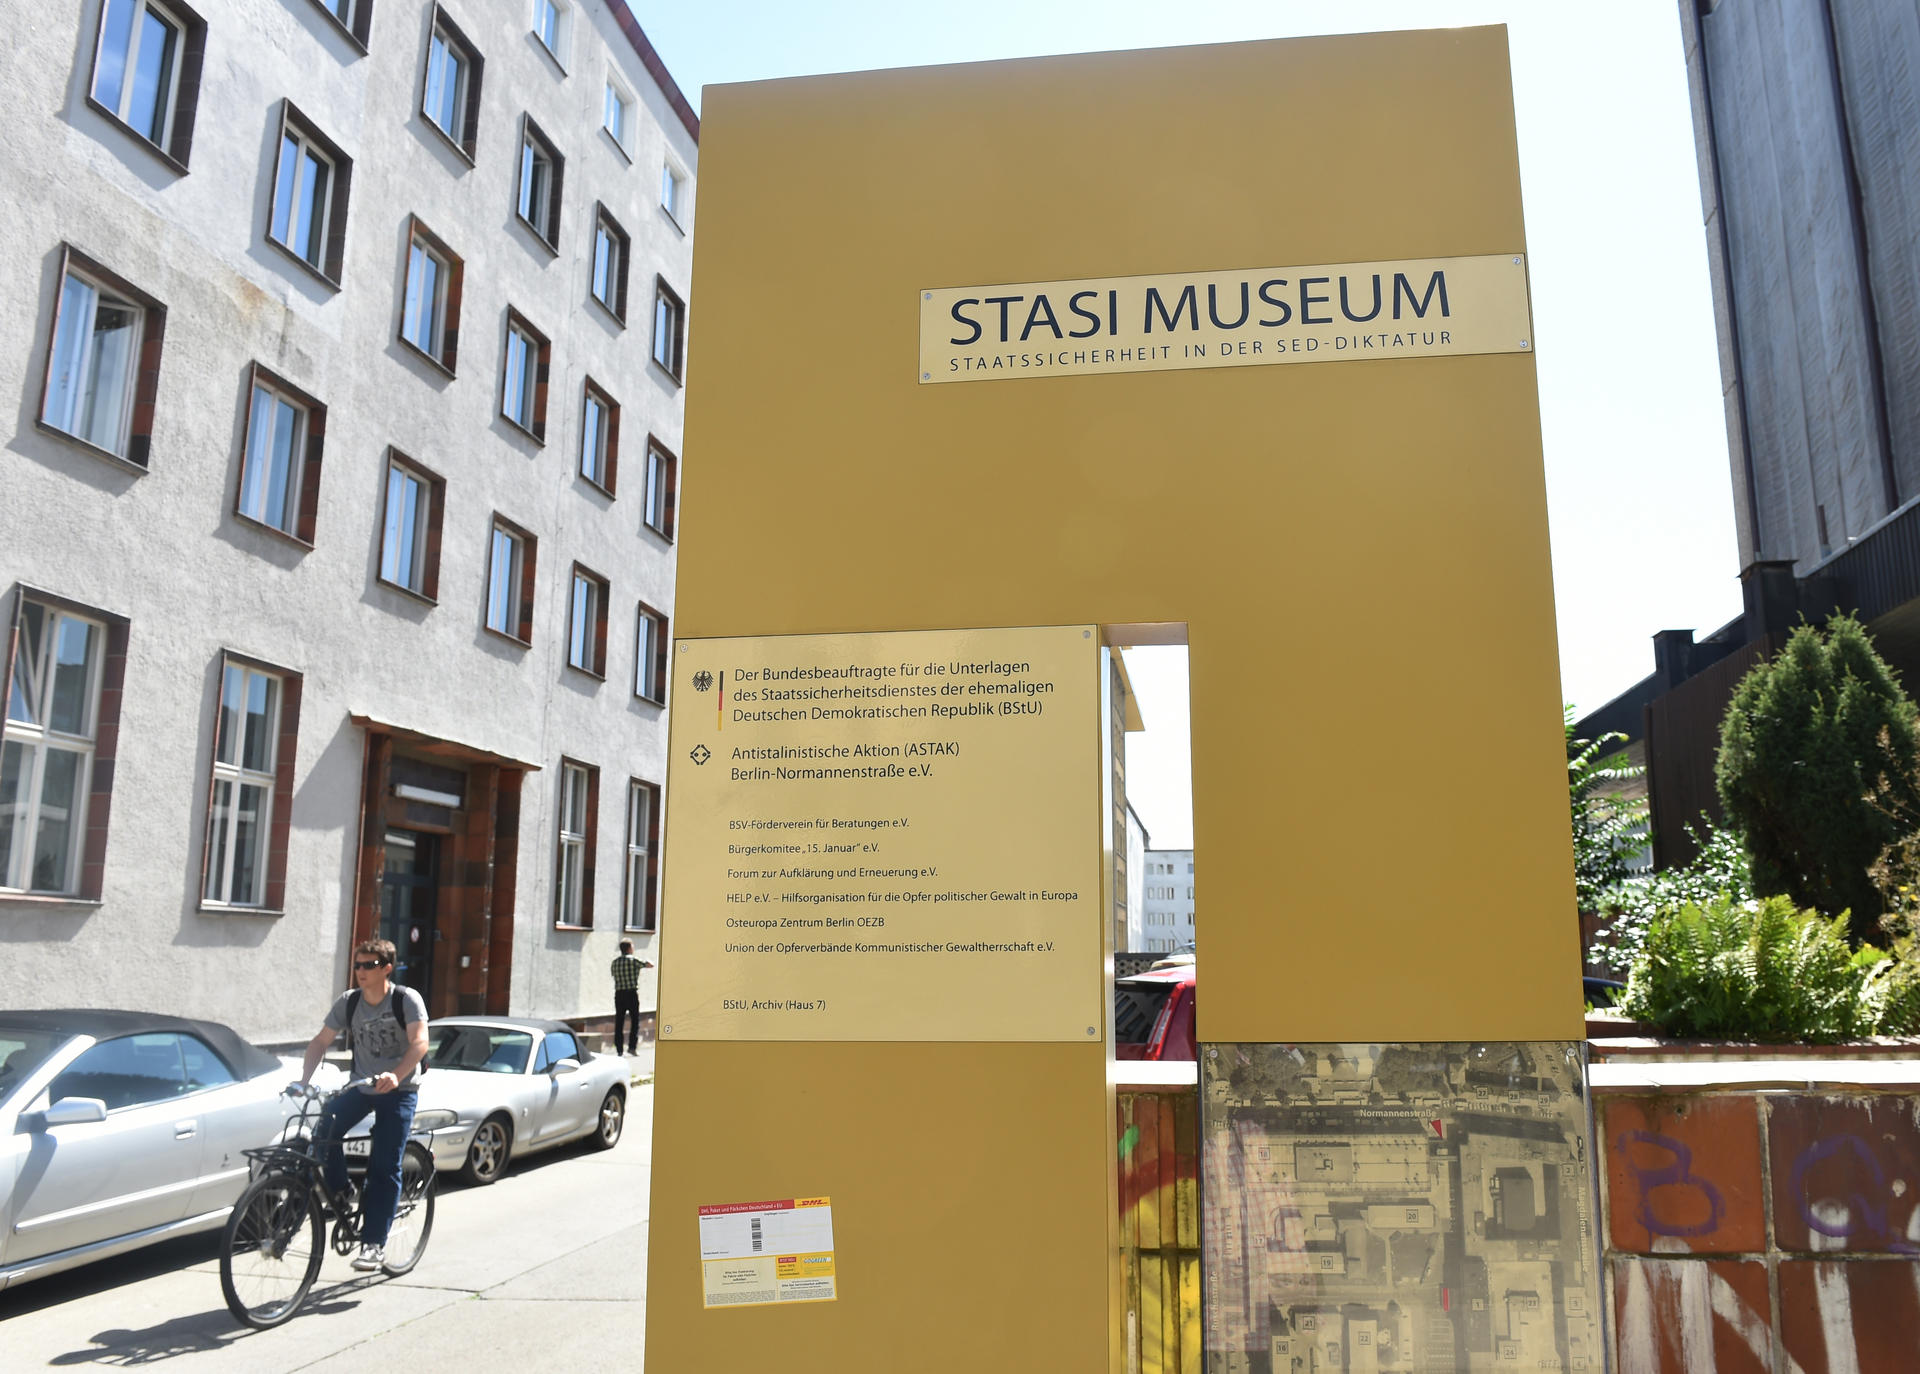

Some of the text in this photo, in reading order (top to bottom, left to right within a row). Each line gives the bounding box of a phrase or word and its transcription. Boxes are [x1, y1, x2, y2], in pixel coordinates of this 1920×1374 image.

[950, 271, 1450, 345] STASI MUSEUM
[950, 331, 1450, 371] STAATSSICHERHEIT IN DER SED-DIKTATUR
[735, 660, 1030, 681] Der Bundesbeauftragte für die Unterlagen
[734, 680, 1053, 701] des Staatssicherheitsdienstes der ehemaligen
[734, 701, 1042, 722] Deutschen Demokratischen Republik (BStU)
[732, 742, 959, 759] Antistalinistische Aktion (ASTAK)
[731, 764, 932, 780] Berlin-Normannenstraße e.V.
[730, 818, 909, 830] BSV-Förderverein für Beratungen e.V.
[863, 843, 880, 852] e.V.
[728, 869, 759, 878] Forum
[779, 868, 834, 880] Aufklärung
[837, 867, 856, 877] und
[859, 867, 918, 879] Erneuerung
[921, 867, 938, 876] e.V.
[727, 893, 752, 903] HELP
[754, 893, 771, 903] e.V.
[782, 892, 865, 905] Hilfsorganisation
[868, 892, 882, 902] für
[884, 892, 900, 902] die
[903, 891, 932, 904] Opfer
[934, 891, 988, 903] politischer
[990, 890, 1026, 901] Gewalt
[1029, 891, 1038, 900] in
[1042, 890, 1078, 902] Europa
[726, 917, 885, 930] Osteuropa Zentrum Berlin OEZB
[725, 941, 1055, 954] Union der Opferverbände Kommunistischer Gewaltherrschaft e.V.
[723, 1000, 826, 1011] BStU, Archiv (Haus 7)
[1360, 1108, 1437, 1118] Normannenstraße
